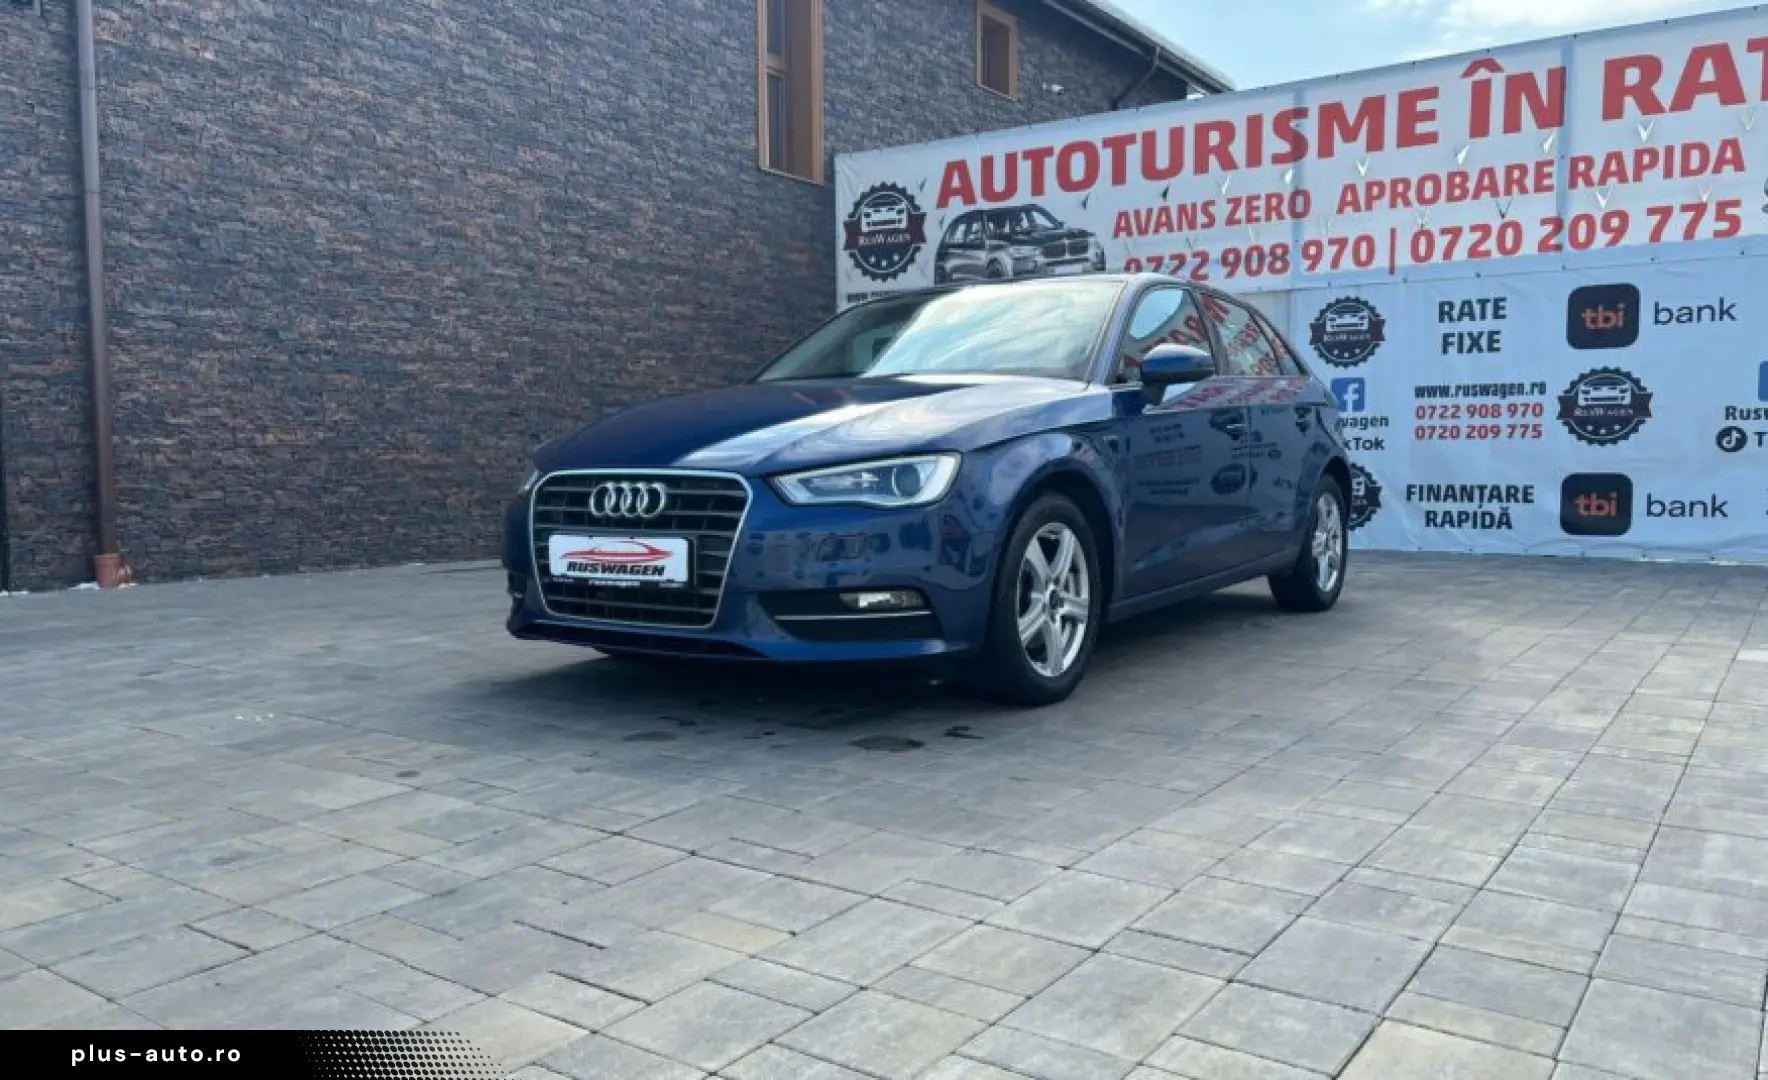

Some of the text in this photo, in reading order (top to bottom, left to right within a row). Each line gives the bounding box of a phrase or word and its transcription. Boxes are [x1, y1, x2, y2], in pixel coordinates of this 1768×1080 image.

[936, 86, 1439, 209] AUTOTURISME
[1460, 57, 1567, 138] ÎN
[1113, 137, 1745, 239] AVANS ZERO APROBARE RAPIDA
[1221, 242, 1290, 280] 908
[1301, 233, 1376, 272] 970
[1410, 220, 1523, 263] 0720
[1537, 209, 1630, 253] 209
[1646, 199, 1742, 243] 775
[1438, 296, 1507, 324] RATE
[1582, 296, 1738, 330] tbi bank
[1441, 330, 1502, 355] FIXE
[1415, 403, 1544, 420] 0722 908 970
[1415, 424, 1543, 439] 0720 209 775
[1406, 484, 1535, 509] FINANȚARE
[1573, 491, 1728, 518] tbi bank
[1425, 506, 1513, 530] RAPIDĂ
[566, 560, 666, 576] RUSWAGEN
